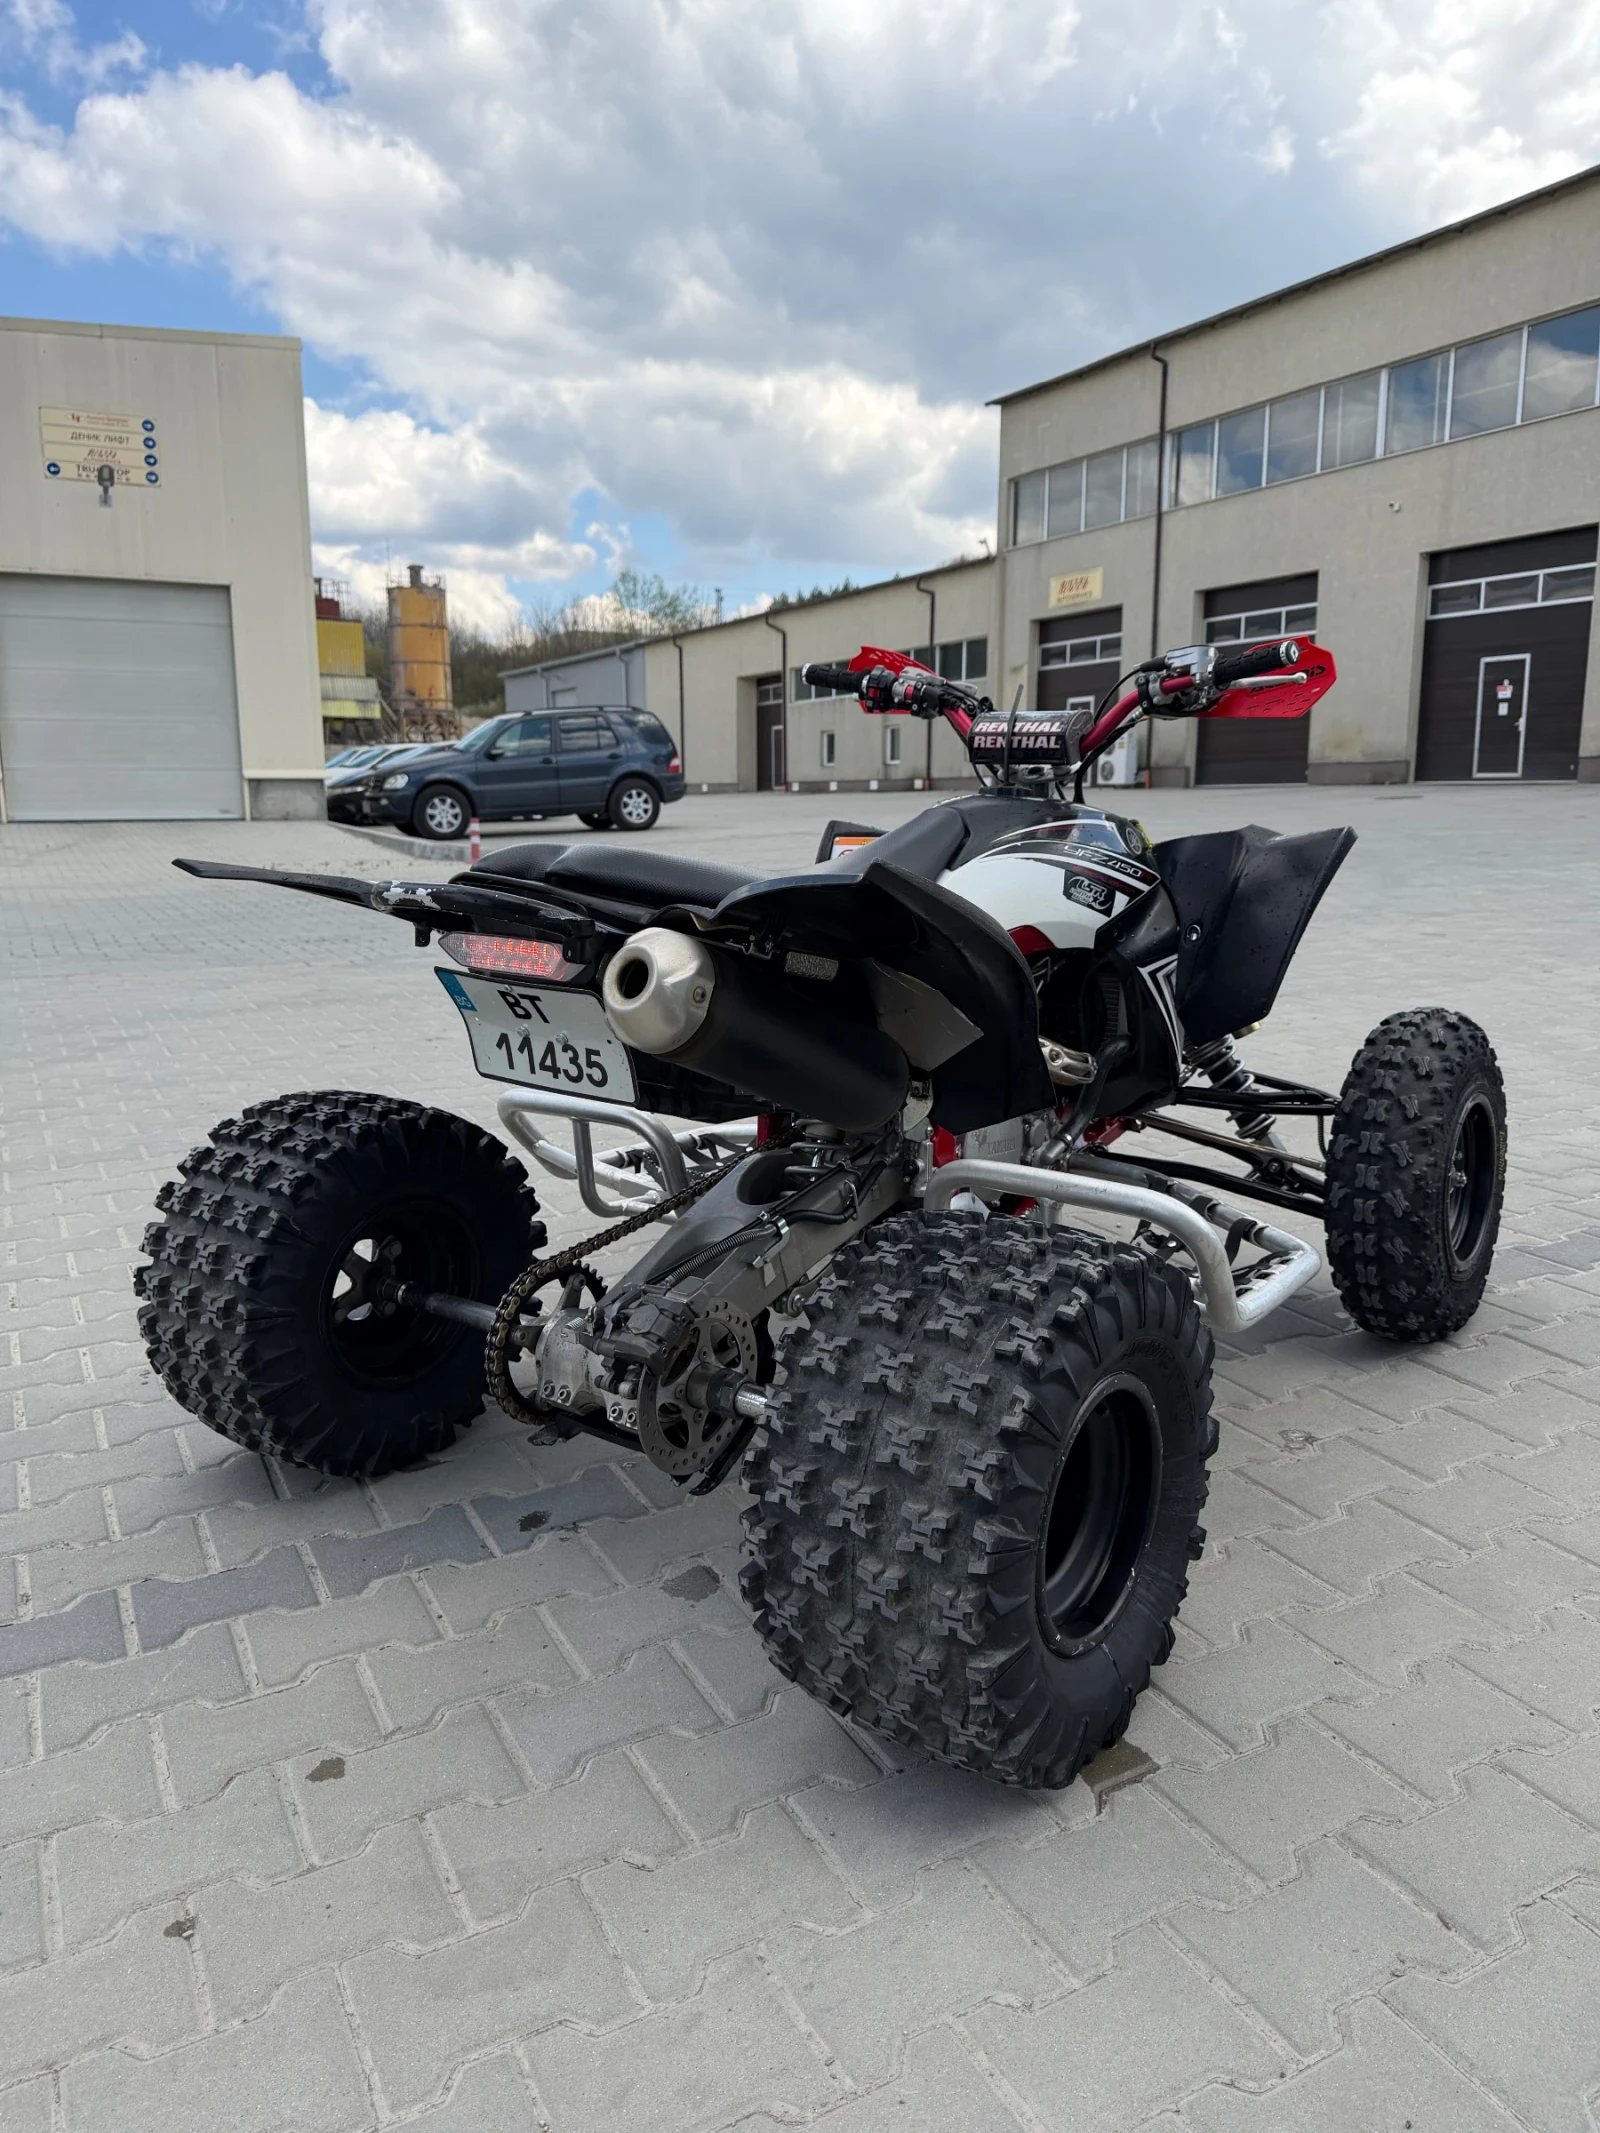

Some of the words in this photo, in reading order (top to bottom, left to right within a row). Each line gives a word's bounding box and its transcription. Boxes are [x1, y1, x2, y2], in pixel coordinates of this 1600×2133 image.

[1063, 845, 1152, 881] YFZ450R
[454, 995, 472, 1008] BG
[496, 989, 550, 1024] BT
[495, 1032, 609, 1088] 11435
